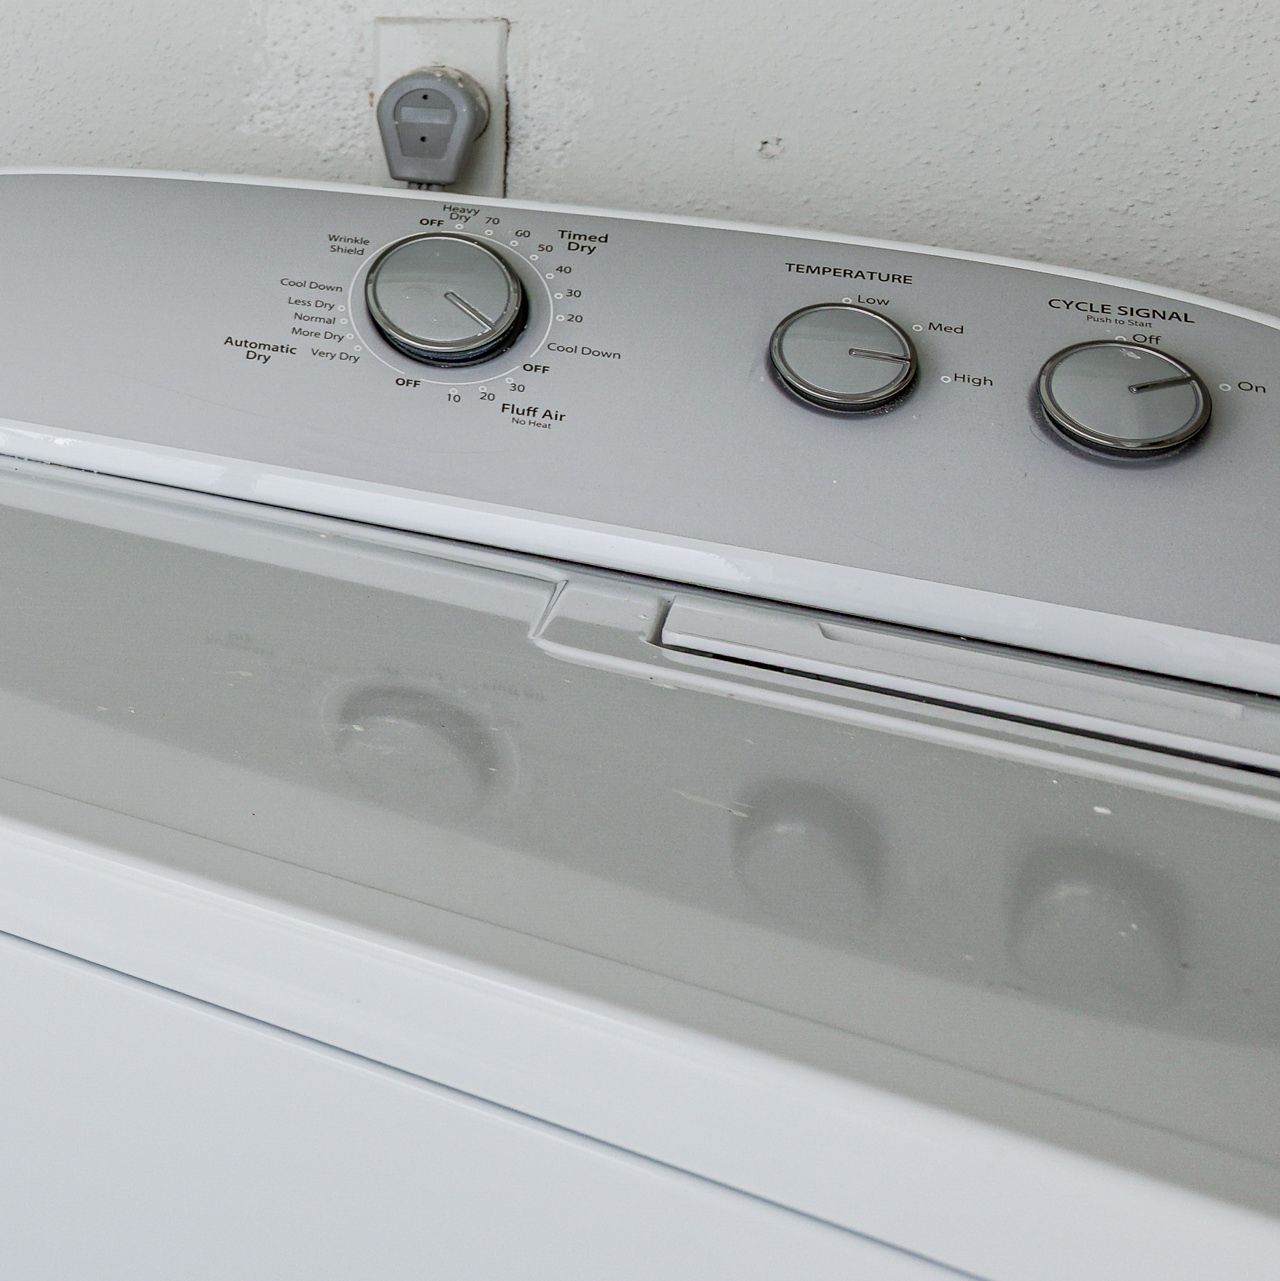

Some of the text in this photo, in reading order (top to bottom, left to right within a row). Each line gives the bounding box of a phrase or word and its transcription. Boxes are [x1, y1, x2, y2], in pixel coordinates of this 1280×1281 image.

[443, 204, 481, 217] Heavy
[419, 218, 445, 227] OFF
[449, 212, 472, 224] Dry
[485, 216, 501, 226] 70
[328, 233, 371, 246] Wrinkle
[514, 229, 532, 238] 60
[557, 229, 609, 244] Timed
[329, 245, 365, 256] Shield
[537, 244, 555, 253] 50
[566, 241, 597, 255] Dry
[555, 265, 572, 274] 40
[785, 262, 913, 285] TEMPERATURE
[280, 277, 343, 293] Cool Down
[565, 289, 582, 298] 30
[288, 296, 335, 311] Less Dry
[857, 294, 890, 306] Low
[1048, 298, 1196, 324] CYCLE SIGNAL
[294, 312, 336, 325] Normal
[566, 314, 584, 323] 20
[1086, 314, 1112, 325] Push
[1127, 319, 1152, 328] Start
[928, 322, 964, 334] Med
[291, 327, 345, 343] More Dry
[1132, 333, 1162, 345] Off
[223, 336, 297, 355] Automatic
[547, 342, 622, 360] Cool Down
[246, 350, 272, 365] Dry
[311, 348, 361, 364] Very Dry
[522, 363, 551, 374] OFF
[394, 377, 421, 389] OFF
[954, 373, 994, 387] High
[509, 383, 526, 393] 30
[1238, 381, 1267, 394] On
[447, 393, 461, 403] 10
[479, 392, 496, 402] 20
[501, 403, 566, 422] Fluff Air
[511, 418, 552, 430] No Heat
